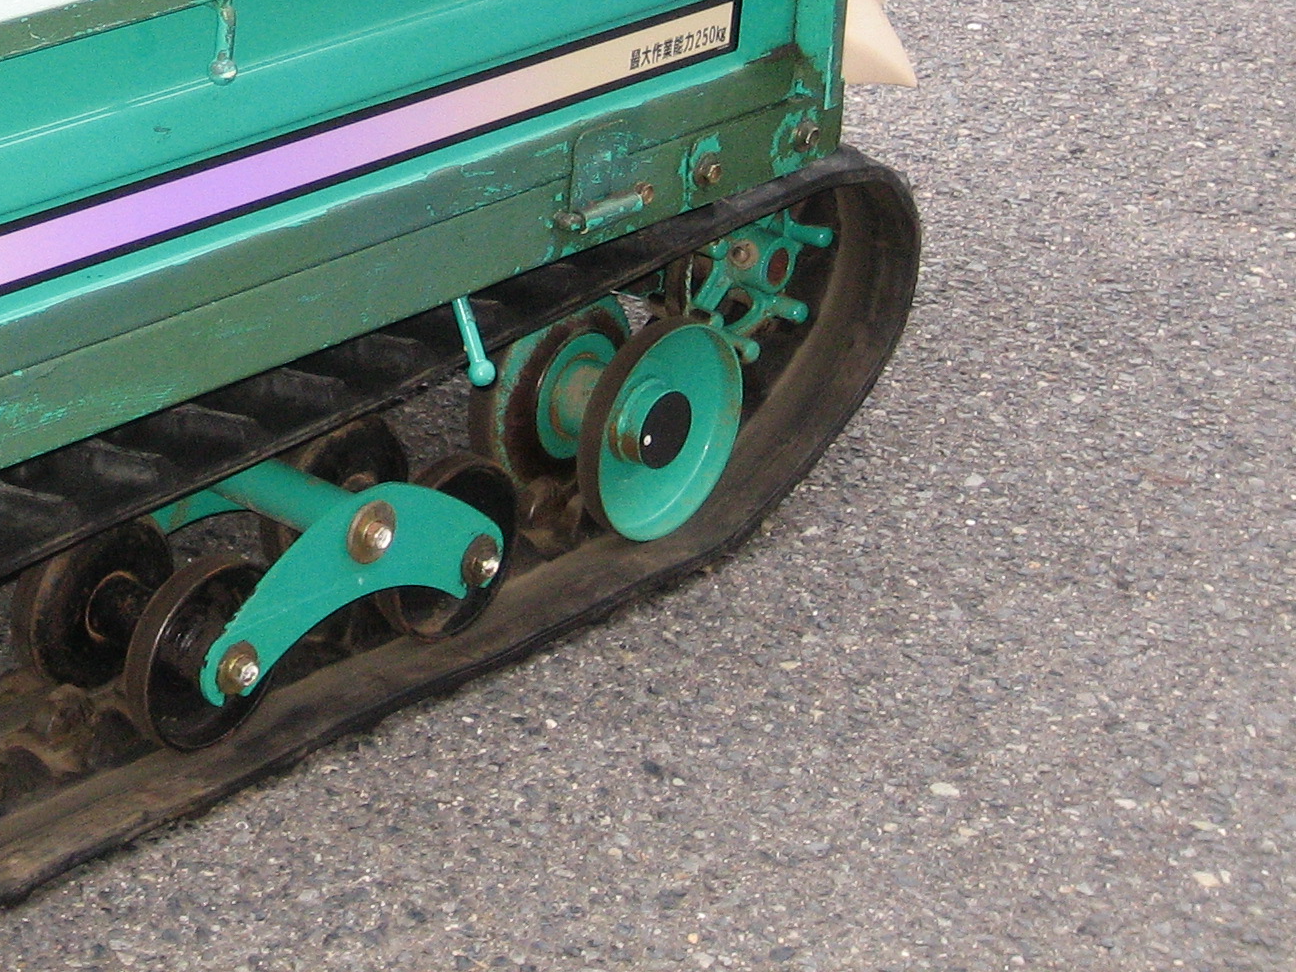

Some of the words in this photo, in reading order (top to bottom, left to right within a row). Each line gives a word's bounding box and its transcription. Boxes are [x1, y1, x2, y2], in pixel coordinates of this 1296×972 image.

[630, 25, 727, 70] 最大作業能力250kg
